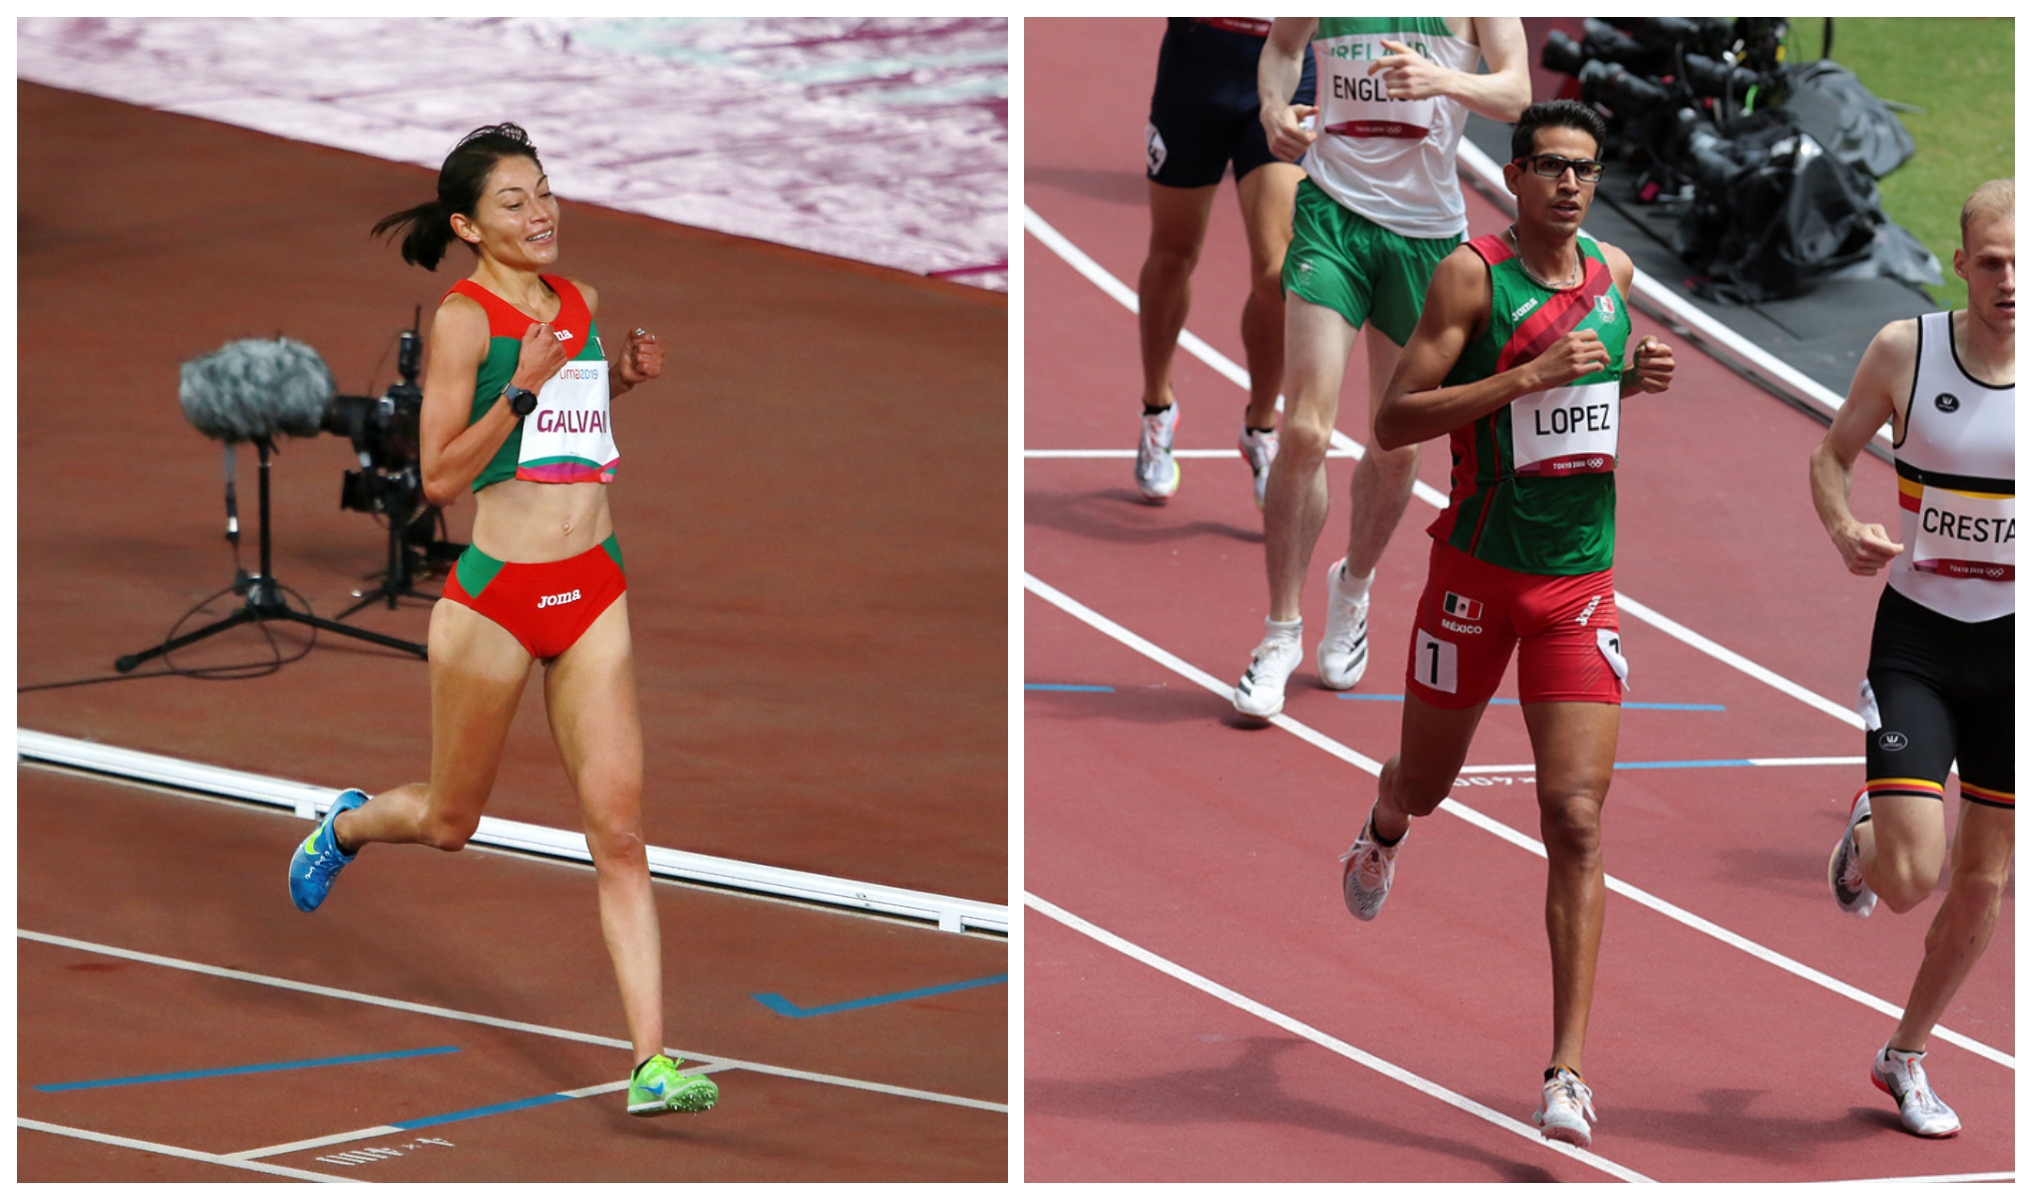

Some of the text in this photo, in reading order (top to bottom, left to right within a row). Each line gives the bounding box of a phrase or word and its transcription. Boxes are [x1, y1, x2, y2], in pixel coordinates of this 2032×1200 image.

[1331, 42, 1428, 61] IRELD
[1333, 75, 1427, 102] ENGL
[1534, 403, 1611, 436] LOPEZ
[537, 589, 582, 609] Joma
[1427, 642, 1439, 686] 1
